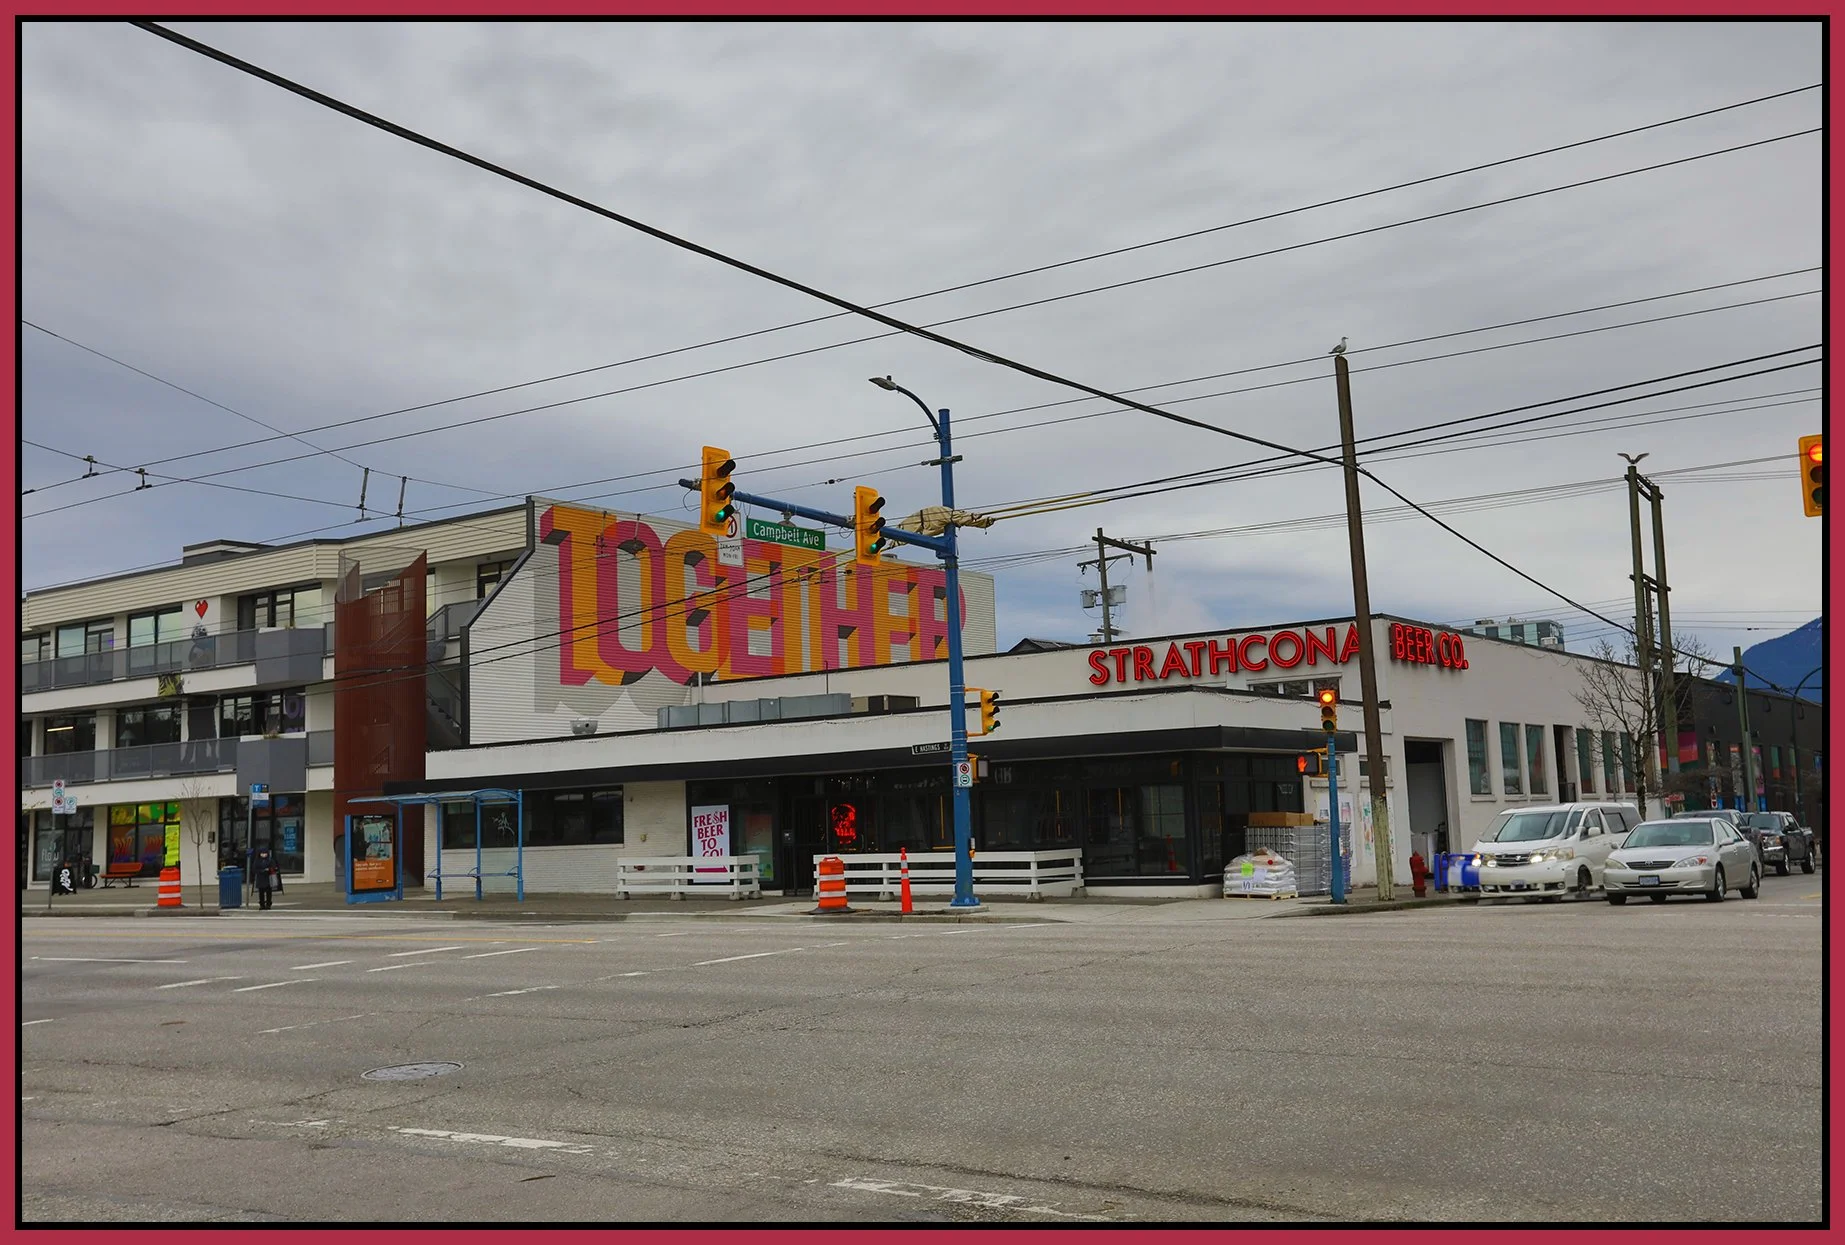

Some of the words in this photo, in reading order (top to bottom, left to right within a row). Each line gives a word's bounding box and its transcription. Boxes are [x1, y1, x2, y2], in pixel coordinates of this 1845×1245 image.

[753, 522, 800, 543] Campbell
[802, 531, 820, 546] Ave
[540, 509, 966, 686] TOGETHER
[1087, 623, 1359, 686] STRATHCONA
[1391, 622, 1437, 665] BEER
[1436, 631, 1470, 670] CO.
[919, 743, 941, 753] HASTINGS
[693, 810, 728, 828] FRESH
[697, 823, 724, 840] BEER
[701, 837, 718, 851] TO
